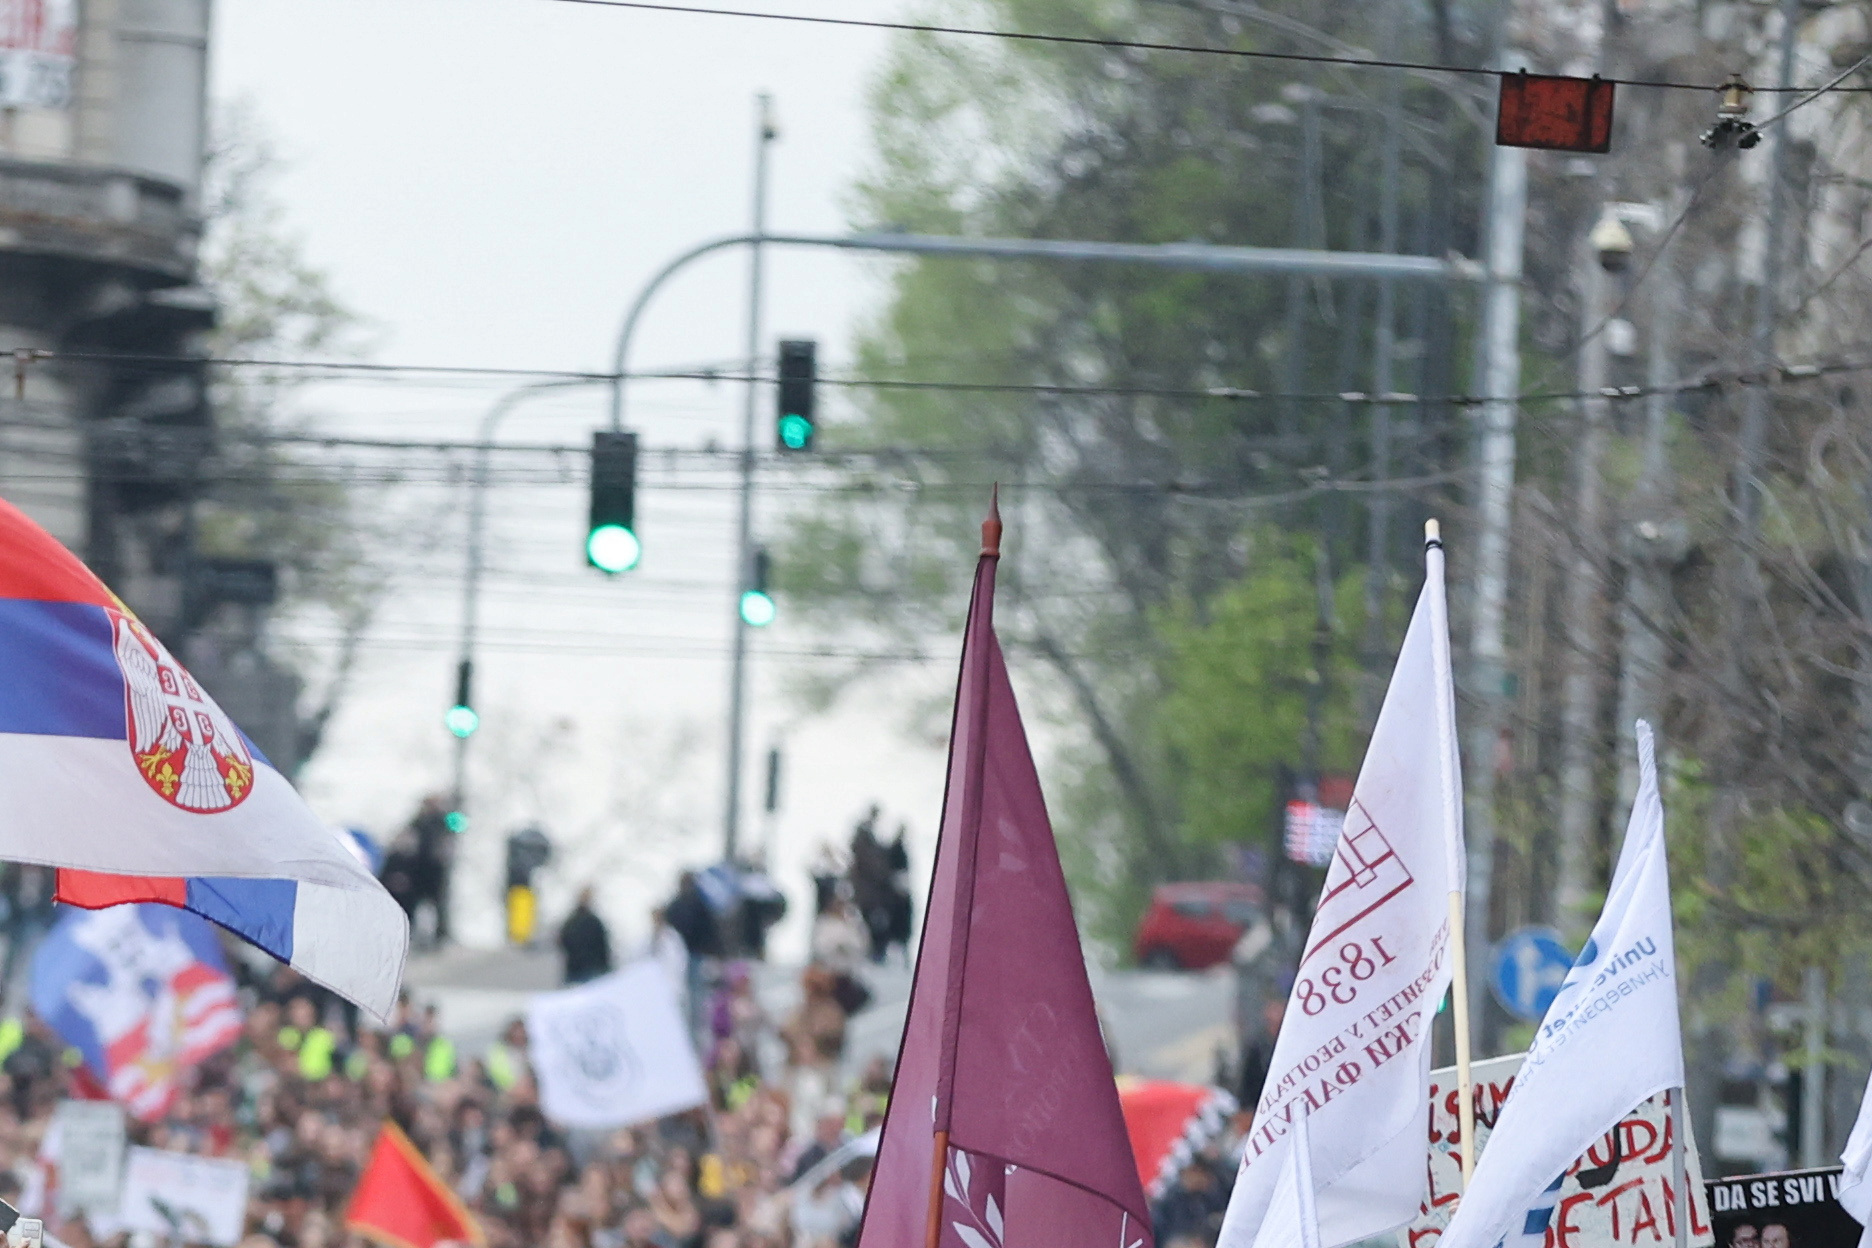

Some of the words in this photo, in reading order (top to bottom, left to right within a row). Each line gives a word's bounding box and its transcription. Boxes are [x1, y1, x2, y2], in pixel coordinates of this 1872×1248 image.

[1713, 1181, 1749, 1213] DA
[1750, 1180, 1780, 1208] SE
[1783, 1175, 1825, 1205] SVI
